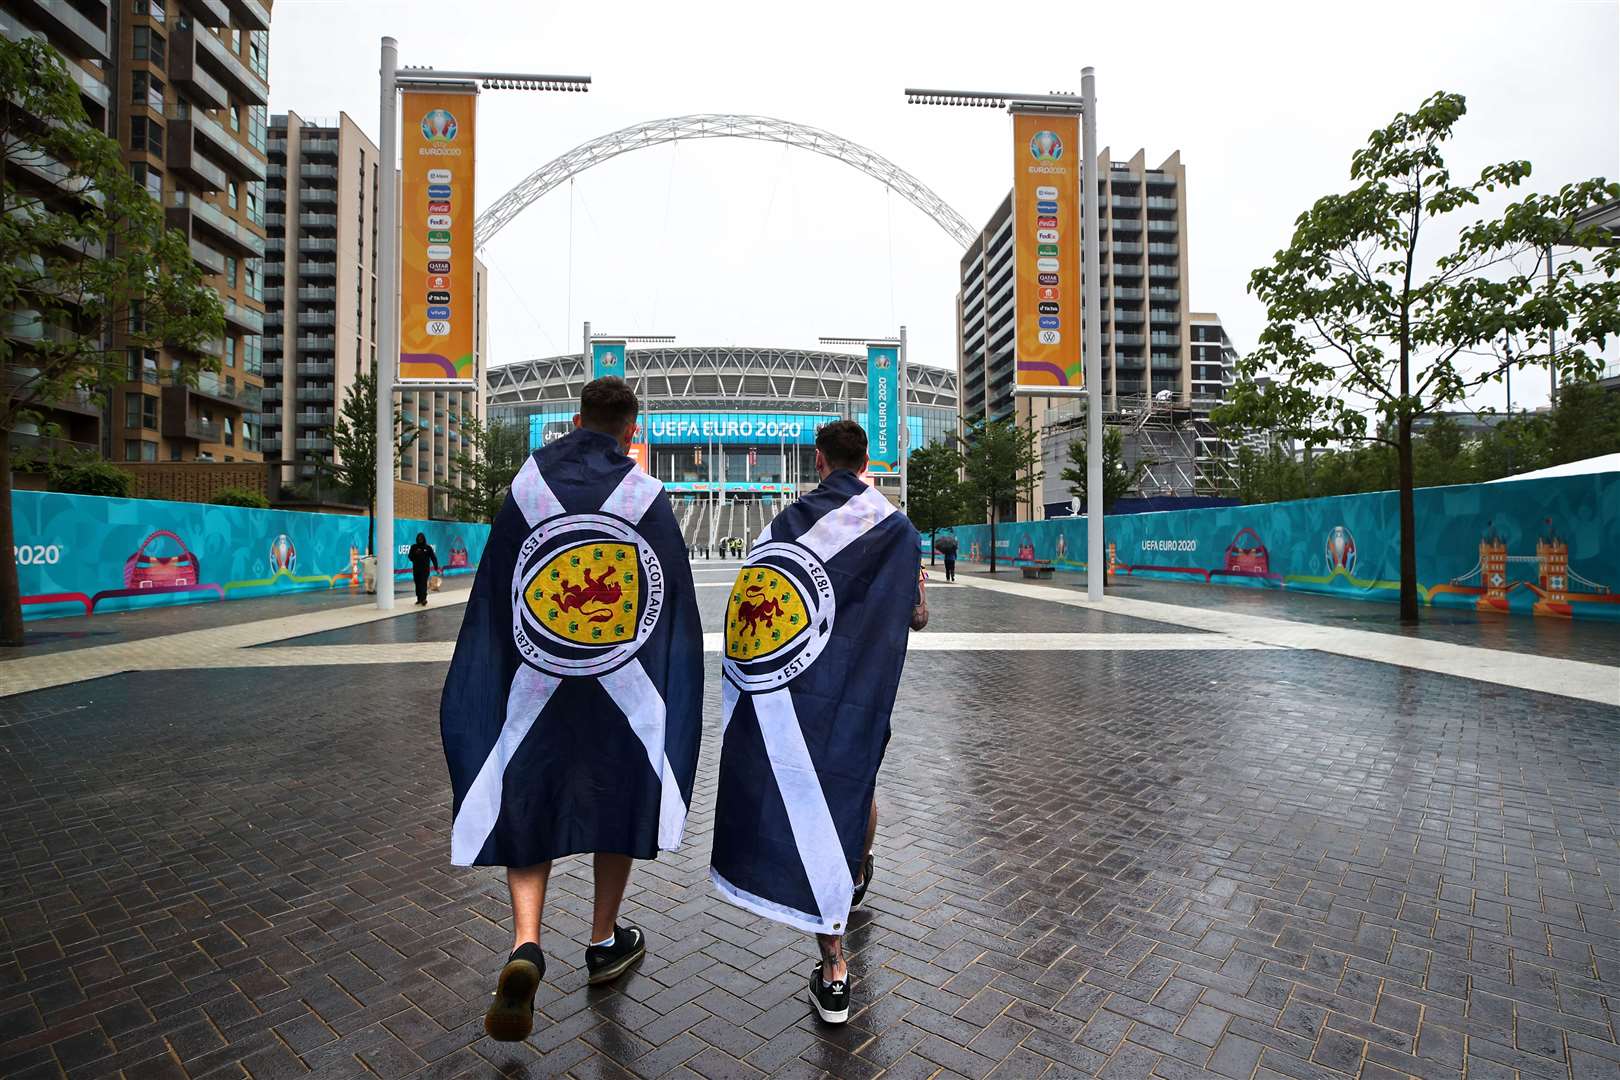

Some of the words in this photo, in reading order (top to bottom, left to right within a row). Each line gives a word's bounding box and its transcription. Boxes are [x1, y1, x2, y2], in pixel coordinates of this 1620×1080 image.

[878, 377, 887, 401] 2020
[879, 402, 887, 429] EURO
[652, 421, 699, 437] UEFA
[703, 421, 753, 437] EURO
[755, 421, 801, 437] 2020
[879, 429, 887, 454] UEFA
[523, 537, 539, 559] EST
[1141, 540, 1158, 551] UEFA
[1159, 540, 1177, 551] EURO
[1178, 540, 1196, 551] 2020
[644, 555, 662, 627] SCOTLAND
[811, 566, 830, 593] 1873
[515, 630, 535, 655] 1873
[783, 659, 804, 679] EST
